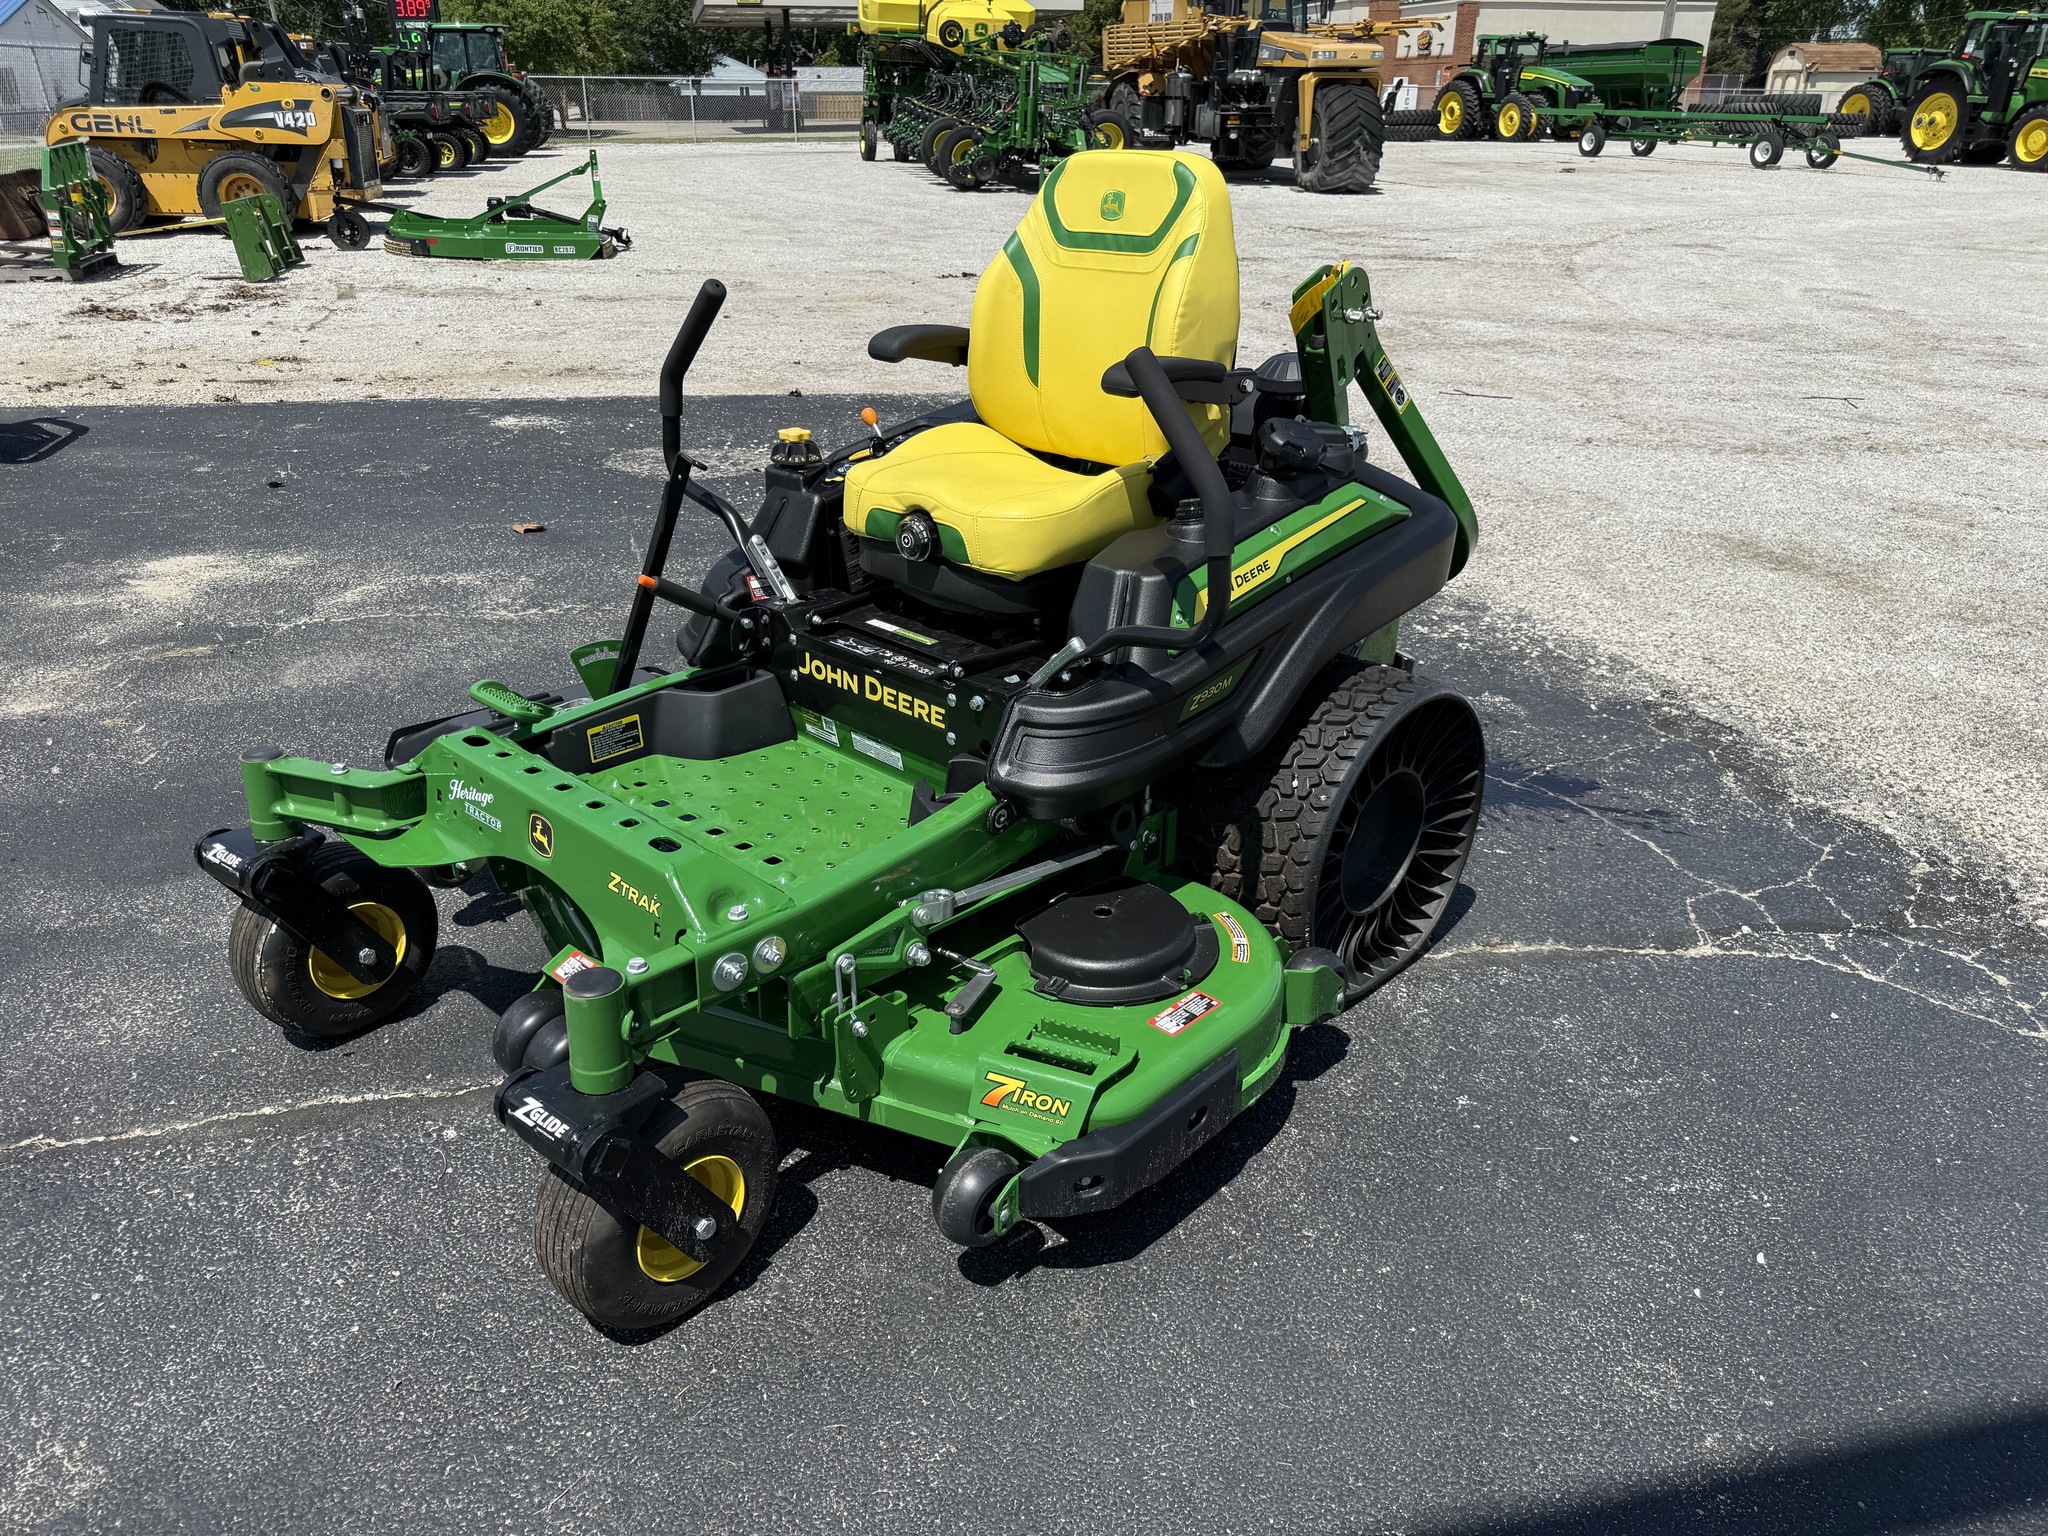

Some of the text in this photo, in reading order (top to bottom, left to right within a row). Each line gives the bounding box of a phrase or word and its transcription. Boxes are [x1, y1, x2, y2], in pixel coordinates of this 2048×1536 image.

[70, 114, 156, 134] GEHL
[274, 110, 317, 128] V420
[505, 243, 544, 254] FRONTIER
[1234, 559, 1271, 589] DEERE
[799, 651, 858, 695] JOHN
[864, 674, 946, 729] DEERE
[1189, 675, 1233, 712] Z930M
[448, 779, 494, 807] Heritage
[465, 803, 502, 832] TRACTOR
[608, 871, 662, 918] ZTRAK
[1002, 1103, 1019, 1113] Mulch
[1028, 1111, 1054, 1123] Demand
